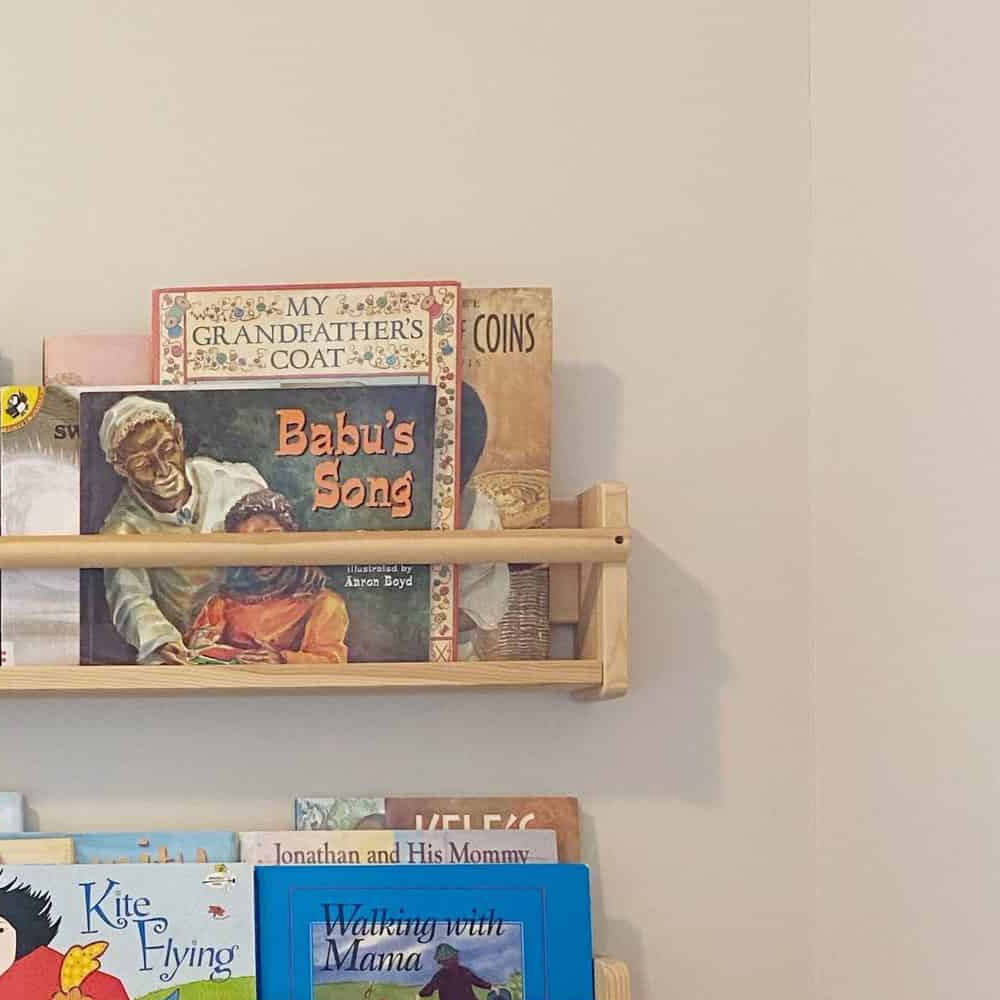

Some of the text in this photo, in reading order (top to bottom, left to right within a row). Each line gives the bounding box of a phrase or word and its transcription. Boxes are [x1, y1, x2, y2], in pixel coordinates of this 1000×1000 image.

[287, 296, 328, 317] MY
[192, 318, 424, 346] GRANDFATHER'S
[474, 312, 535, 354] COINS
[270, 348, 346, 370] COAT
[275, 409, 416, 457] Babu's
[312, 457, 415, 519] Song
[344, 575, 413, 589] Aaron Boyd
[273, 841, 529, 866] Jonathan and His Mommy
[79, 878, 151, 934] Kite
[322, 903, 505, 944] Walking with
[133, 917, 239, 982] Flying
[323, 938, 425, 972] Mama
